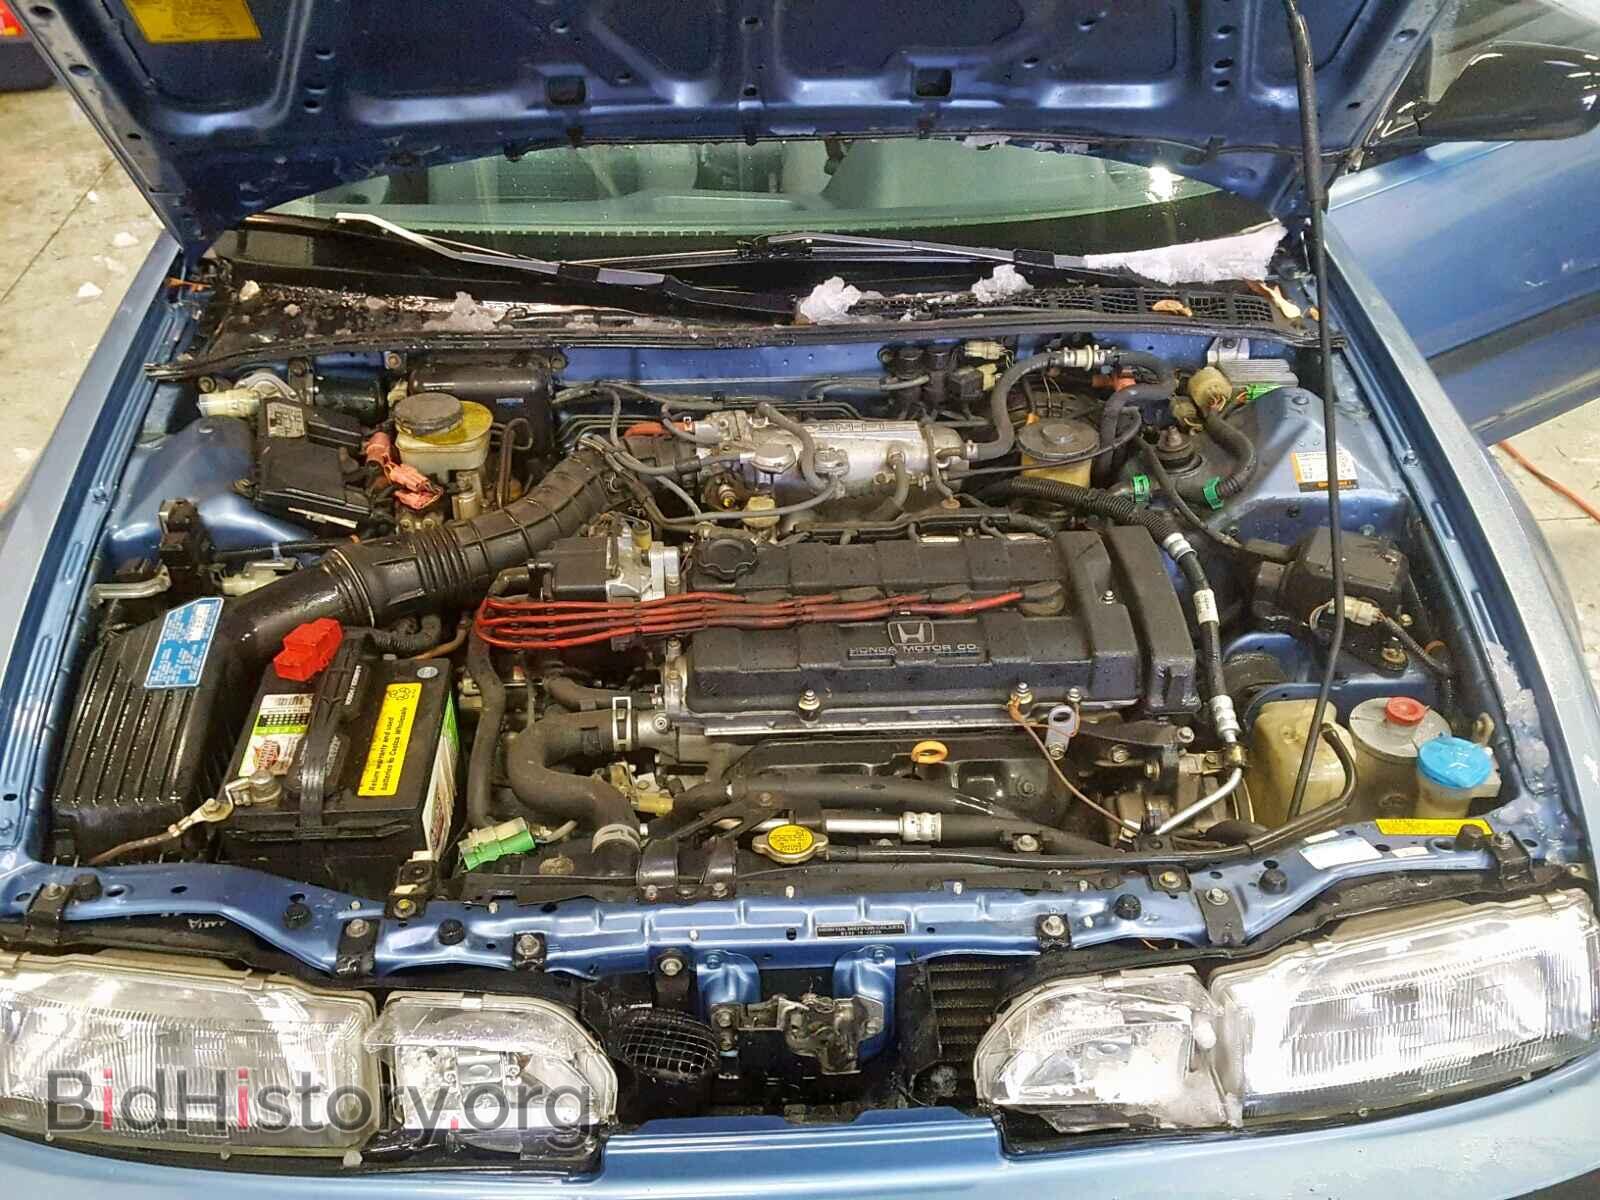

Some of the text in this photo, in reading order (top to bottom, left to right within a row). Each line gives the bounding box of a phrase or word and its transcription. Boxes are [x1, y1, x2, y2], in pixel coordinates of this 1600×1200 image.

[848, 646, 897, 656] HONDA
[903, 644, 951, 654] MOTOR
[376, 744, 388, 769] warranty
[386, 717, 394, 731] used
